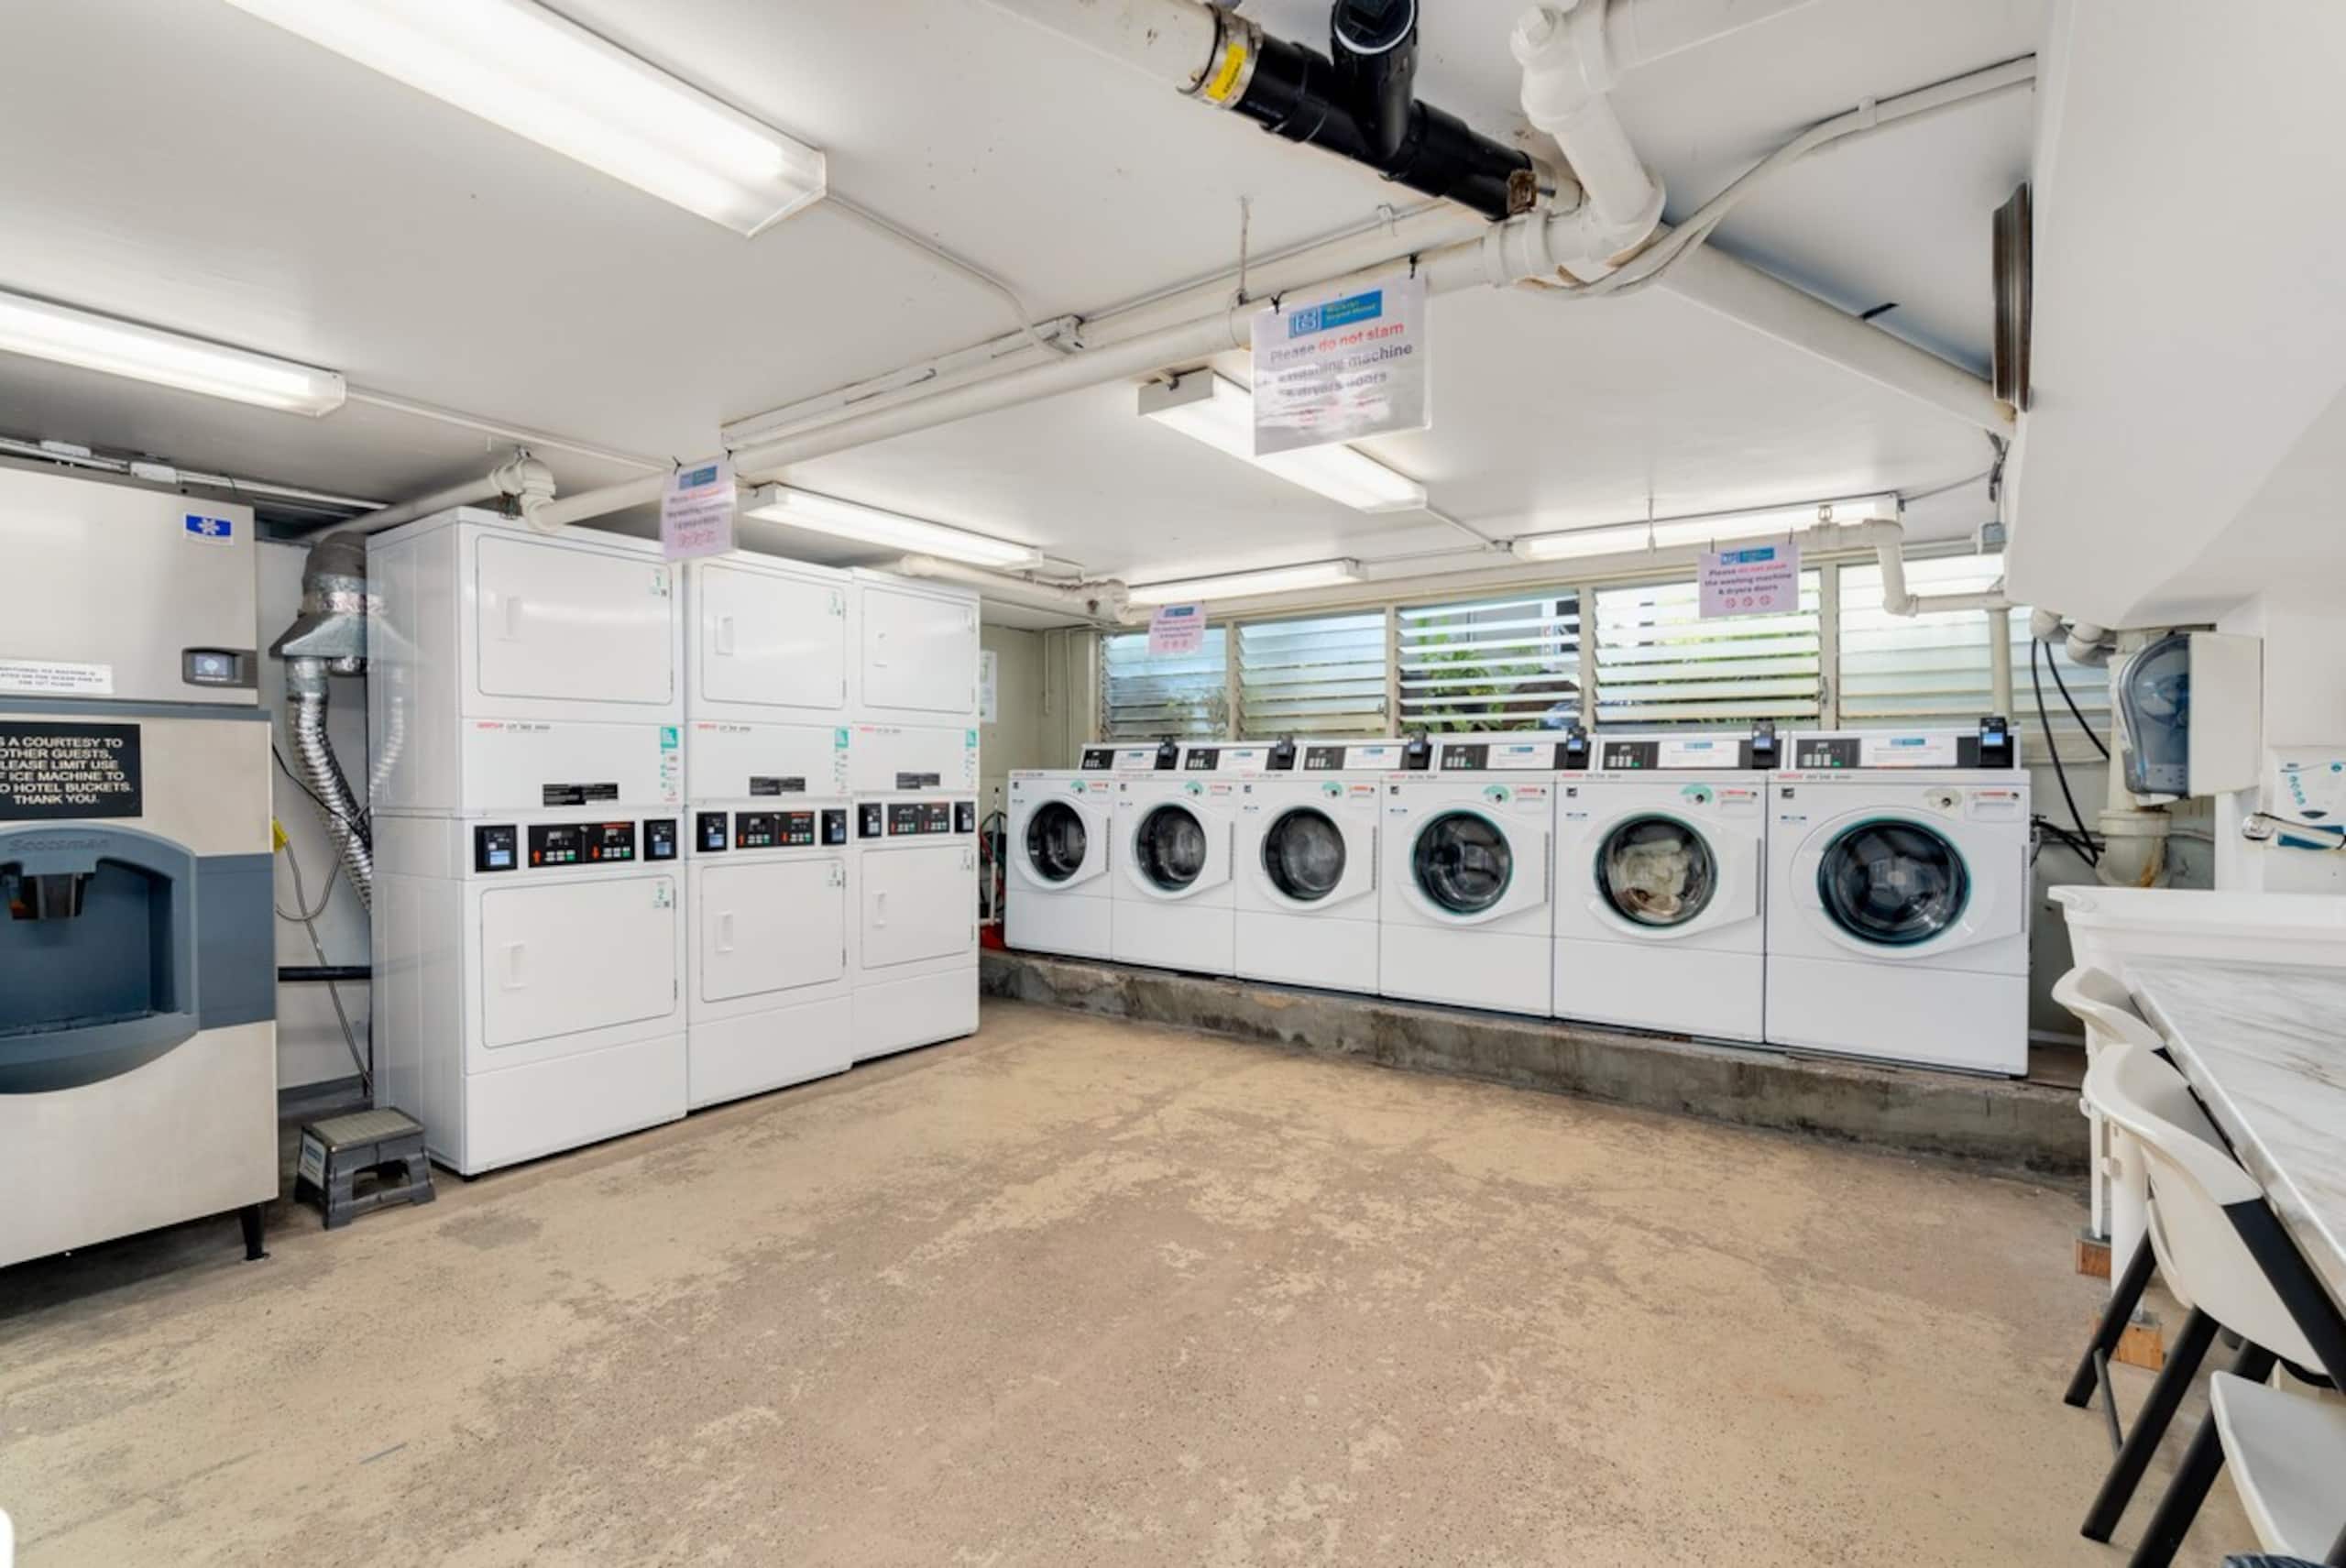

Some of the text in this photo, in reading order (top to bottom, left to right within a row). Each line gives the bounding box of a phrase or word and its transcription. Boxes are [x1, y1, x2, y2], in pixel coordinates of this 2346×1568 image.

[1319, 338, 1336, 352] do
[1340, 332, 1363, 345] not
[1368, 322, 1404, 340] slam
[1348, 344, 1413, 367] machine
[8, 737, 19, 748] A
[22, 737, 101, 748] COURTESY
[104, 738, 124, 748] TO
[0, 749, 49, 760] OTHER
[0, 760, 119, 771] LEASE LIMIT USE
[9, 771, 35, 782] ICE
[37, 771, 103, 782] MACHINE
[104, 772, 125, 782] TO
[13, 783, 62, 794] HOTEL
[13, 794, 63, 805] THANK
